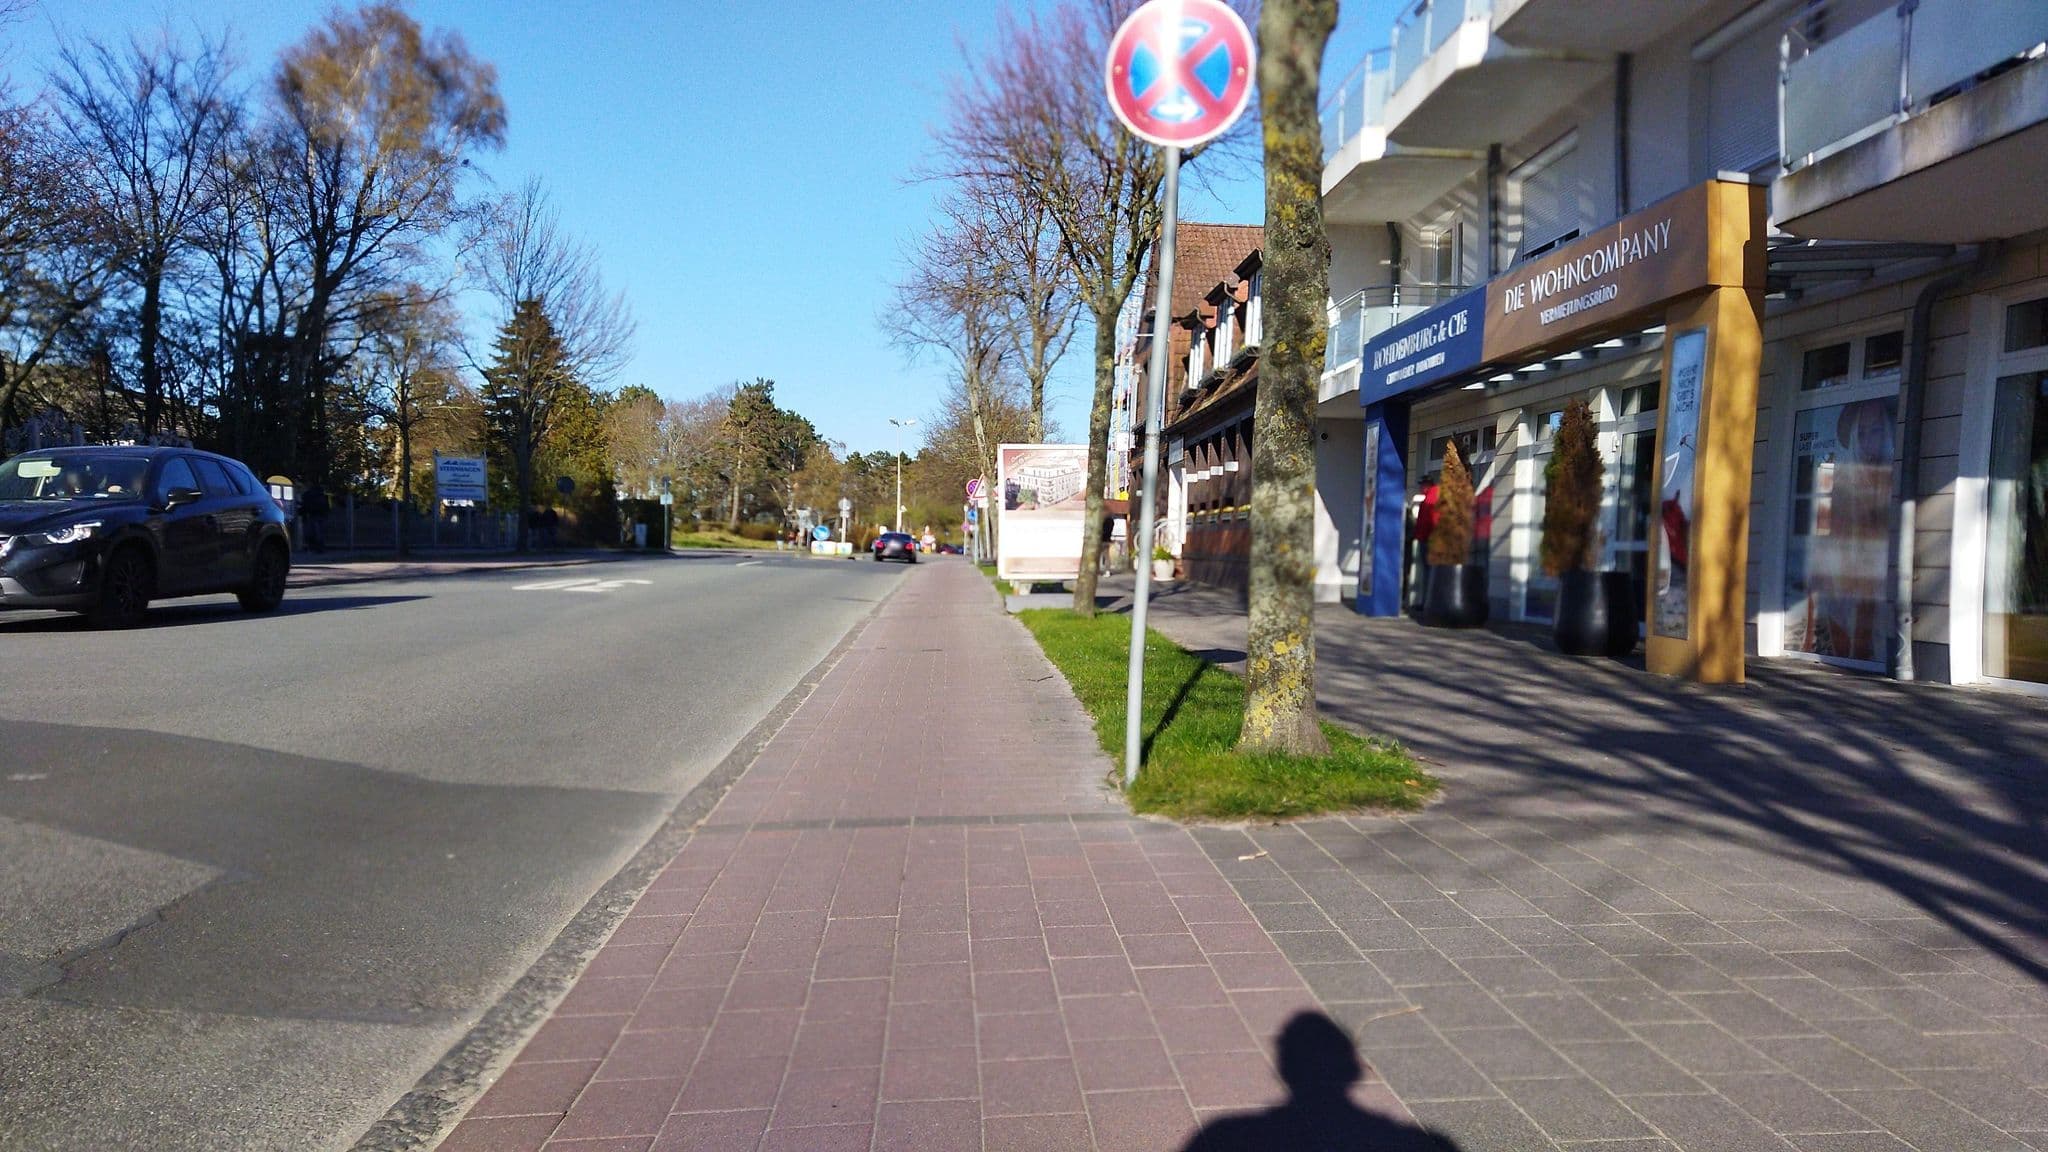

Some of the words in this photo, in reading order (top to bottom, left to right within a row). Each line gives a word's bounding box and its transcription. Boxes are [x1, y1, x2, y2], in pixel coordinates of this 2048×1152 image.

[1504, 282, 1526, 315] DIE
[1530, 218, 1672, 305] WOHNCOMPANY
[1540, 284, 1618, 326] VERMIETUNGSBÜRO
[1373, 323, 1438, 371] ROHDENBURG
[1437, 319, 1448, 342] &
[1448, 309, 1468, 338] CIE
[1799, 431, 1819, 442] SUPER
